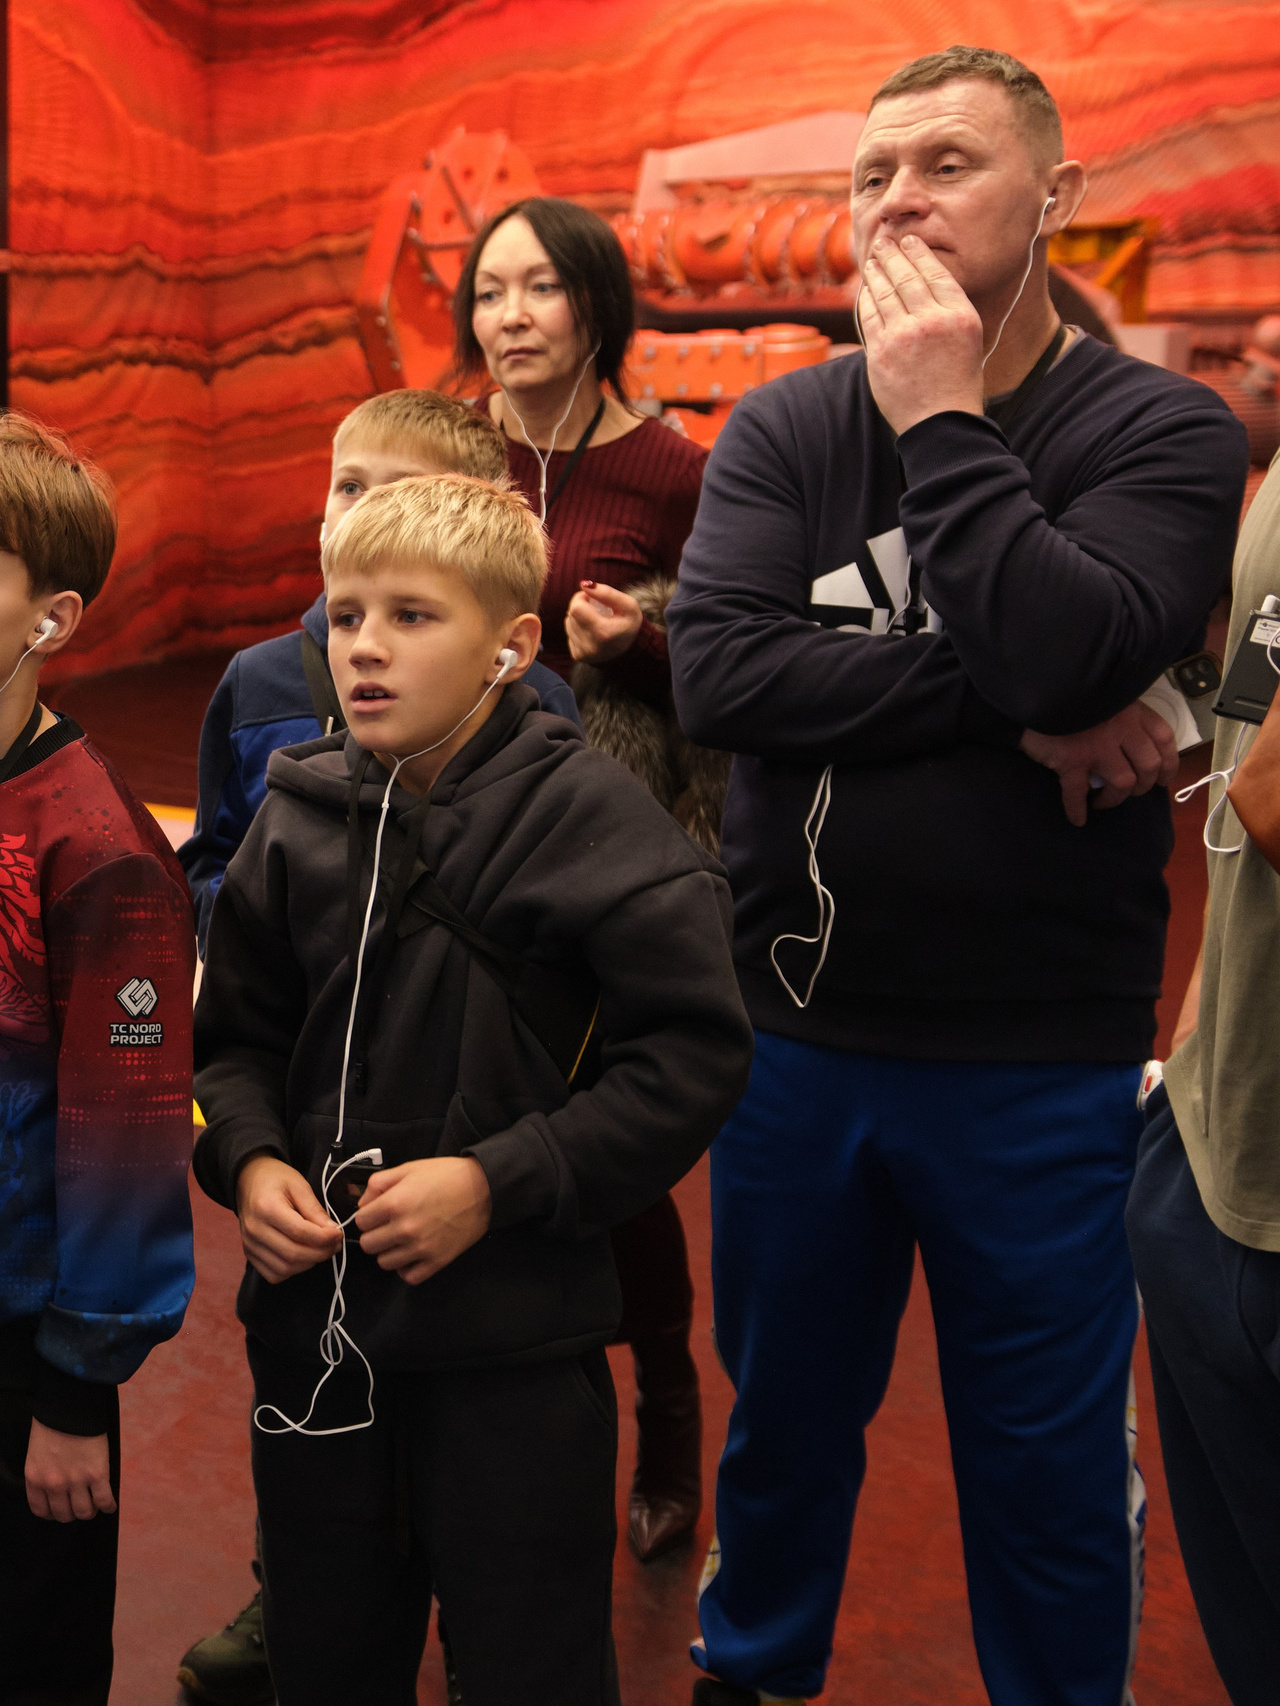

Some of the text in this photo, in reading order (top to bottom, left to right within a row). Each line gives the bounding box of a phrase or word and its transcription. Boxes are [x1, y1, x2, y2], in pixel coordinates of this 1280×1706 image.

[111, 1024, 161, 1033] TC NORD
[111, 1035, 162, 1044] PROJECT
